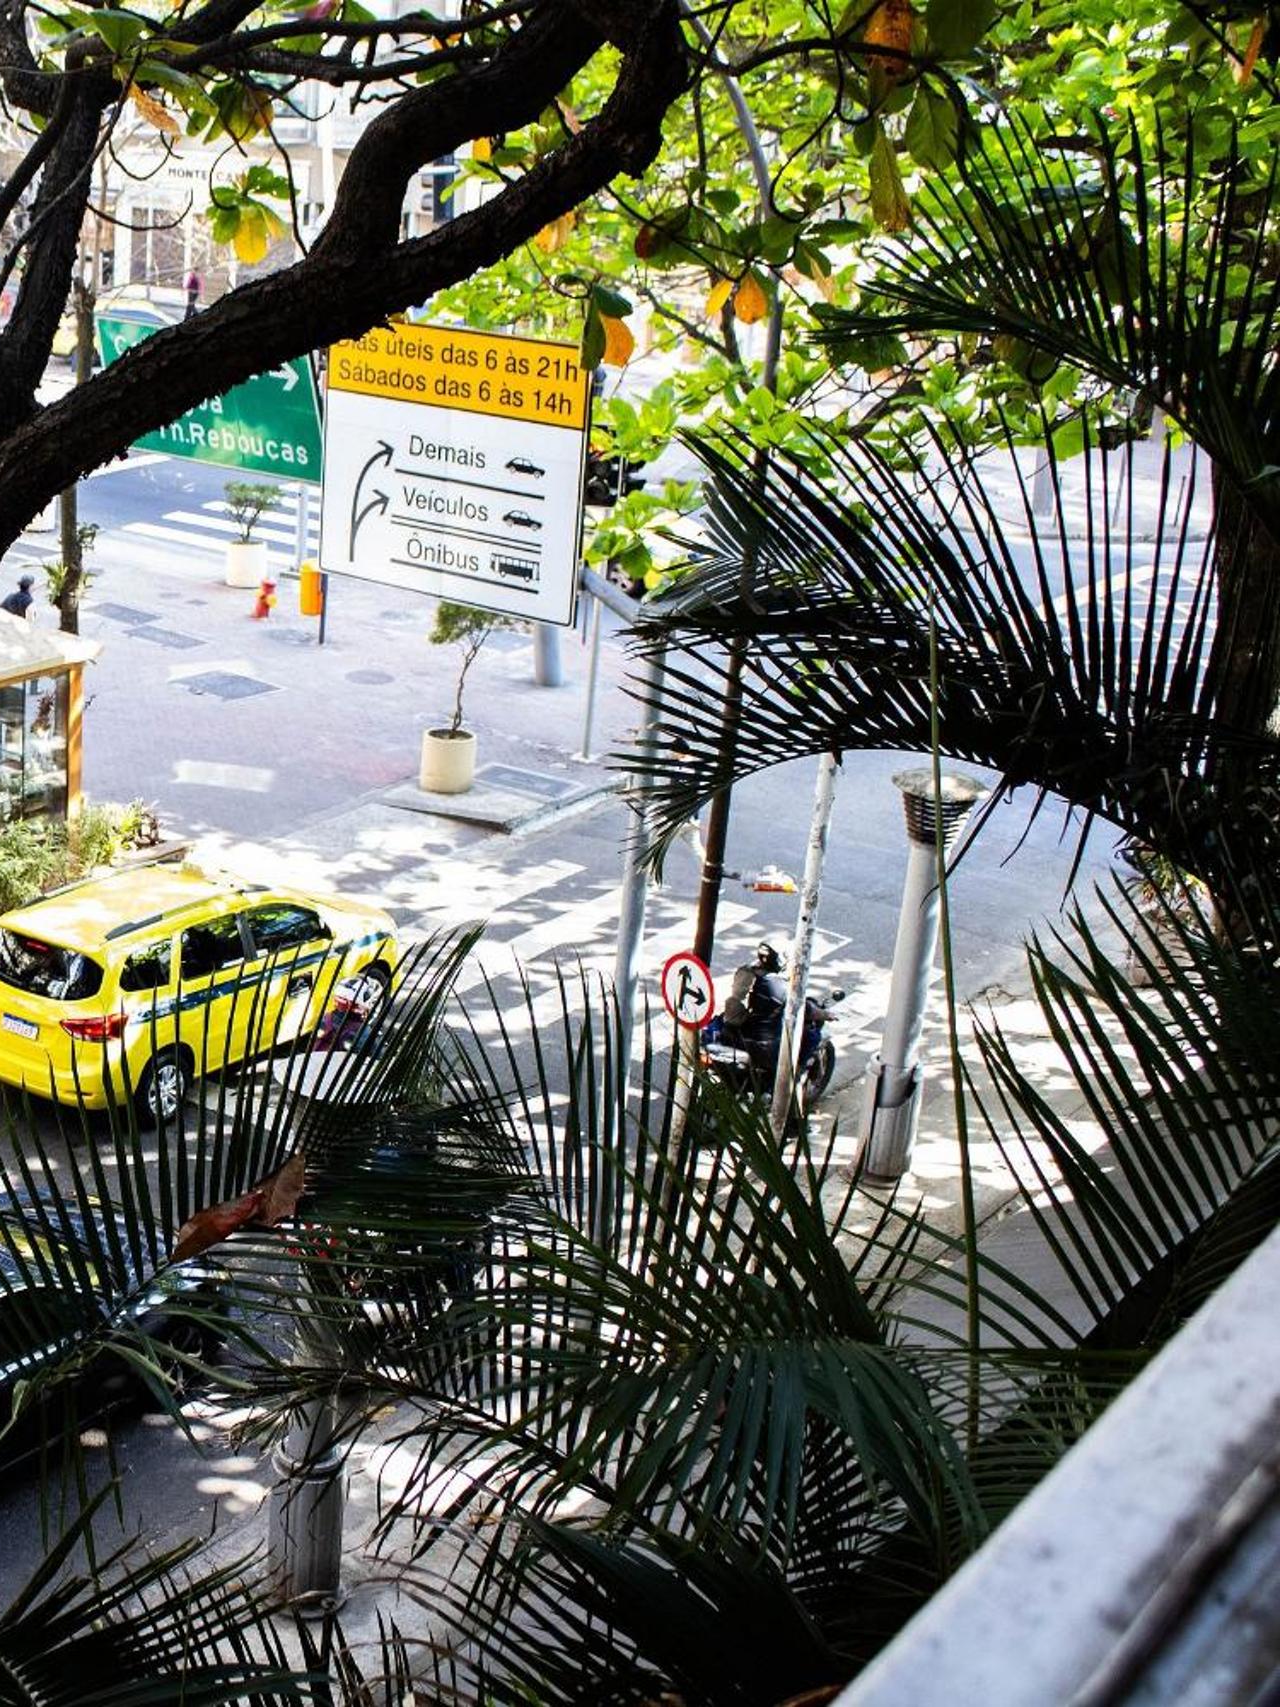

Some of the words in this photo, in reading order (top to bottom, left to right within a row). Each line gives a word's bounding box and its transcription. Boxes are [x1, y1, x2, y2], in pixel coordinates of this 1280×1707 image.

[168, 167, 207, 181] MONTE
[441, 343, 478, 367] das
[485, 350, 498, 371] 6
[505, 351, 529, 375] às
[537, 356, 578, 382] 21h
[339, 358, 426, 392] Sábados
[435, 375, 471, 400] das
[478, 380, 491, 402] 6
[500, 382, 524, 407] às
[534, 389, 572, 415] 14h
[409, 434, 486, 469] Demais
[403, 485, 489, 522] Veículos
[407, 532, 480, 571] Ônibus
